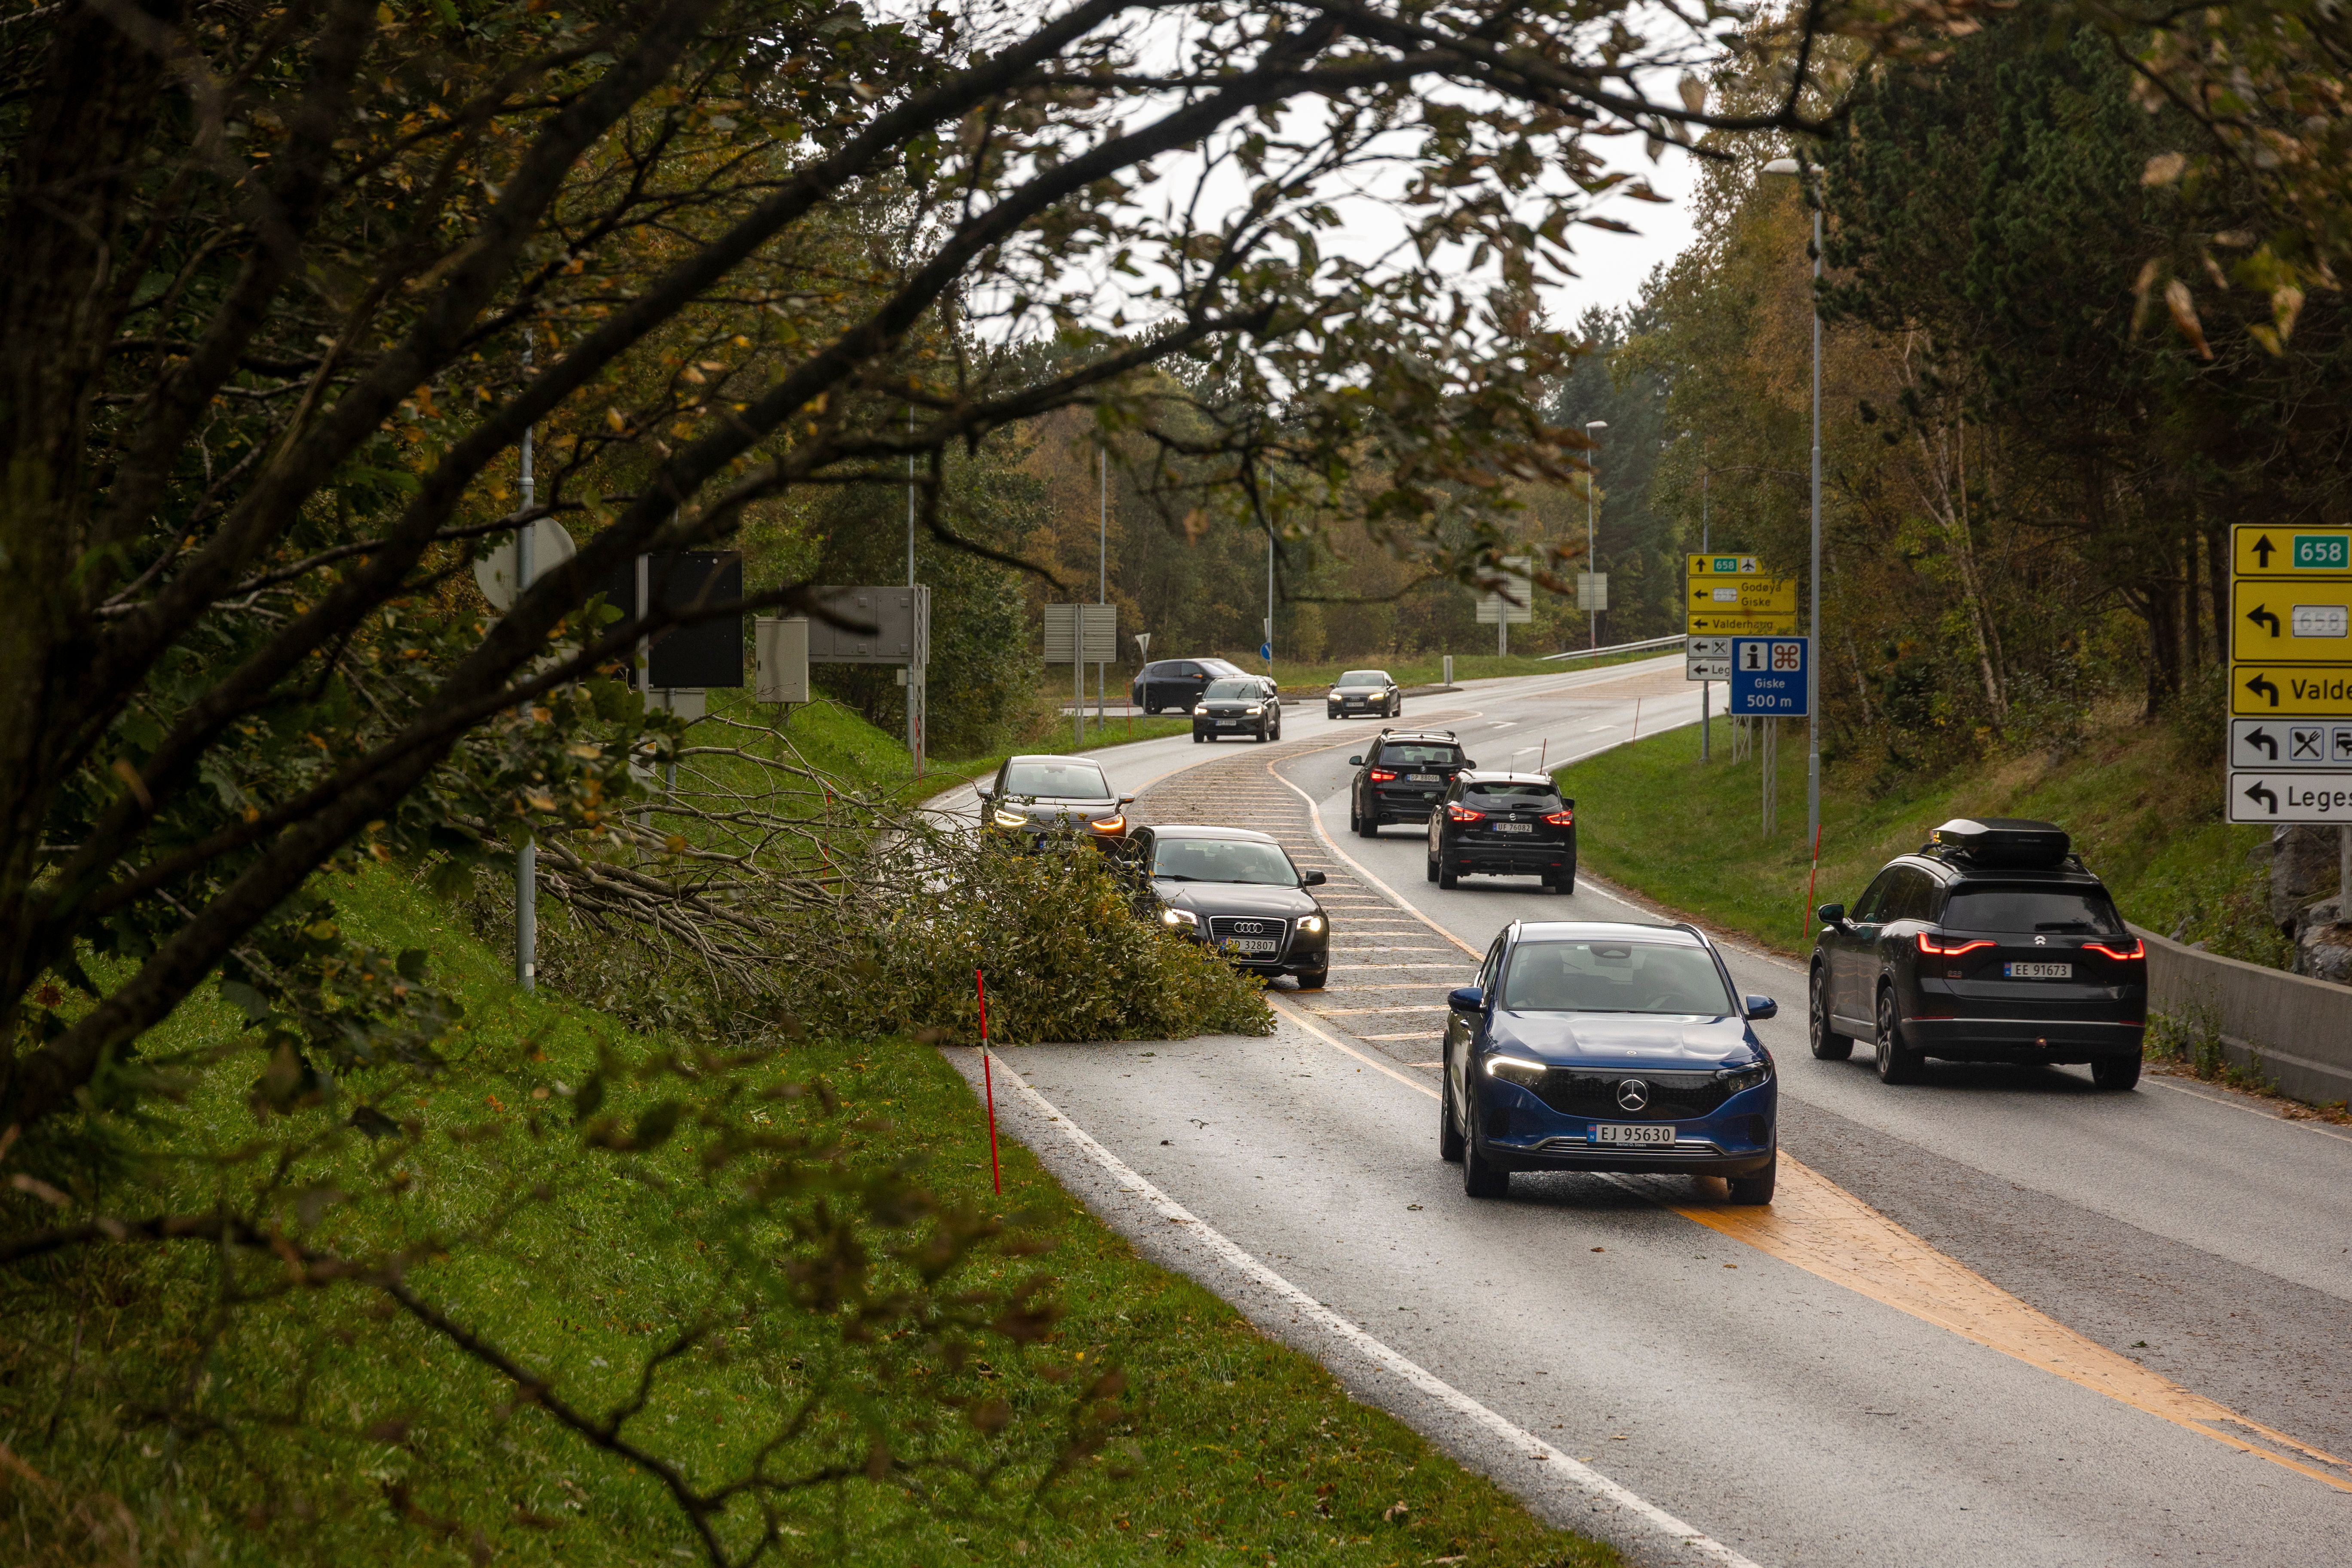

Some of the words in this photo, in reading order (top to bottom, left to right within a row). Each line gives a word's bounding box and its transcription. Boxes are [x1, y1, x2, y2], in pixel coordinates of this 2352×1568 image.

[2300, 542, 2342, 561] 658
[1716, 560, 1735, 570] 658
[1742, 582, 1781, 594] Godøya
[1742, 597, 1771, 606] Giske
[1755, 678, 1785, 688] Giske
[1747, 695, 1776, 707] 500
[1780, 698, 1792, 707] m
[1245, 940, 1273, 950] 32807
[2016, 965, 2028, 975] EE
[2034, 965, 2067, 976] 91673
[1602, 1127, 1617, 1140] EJ
[1624, 1127, 1670, 1142] 95630
